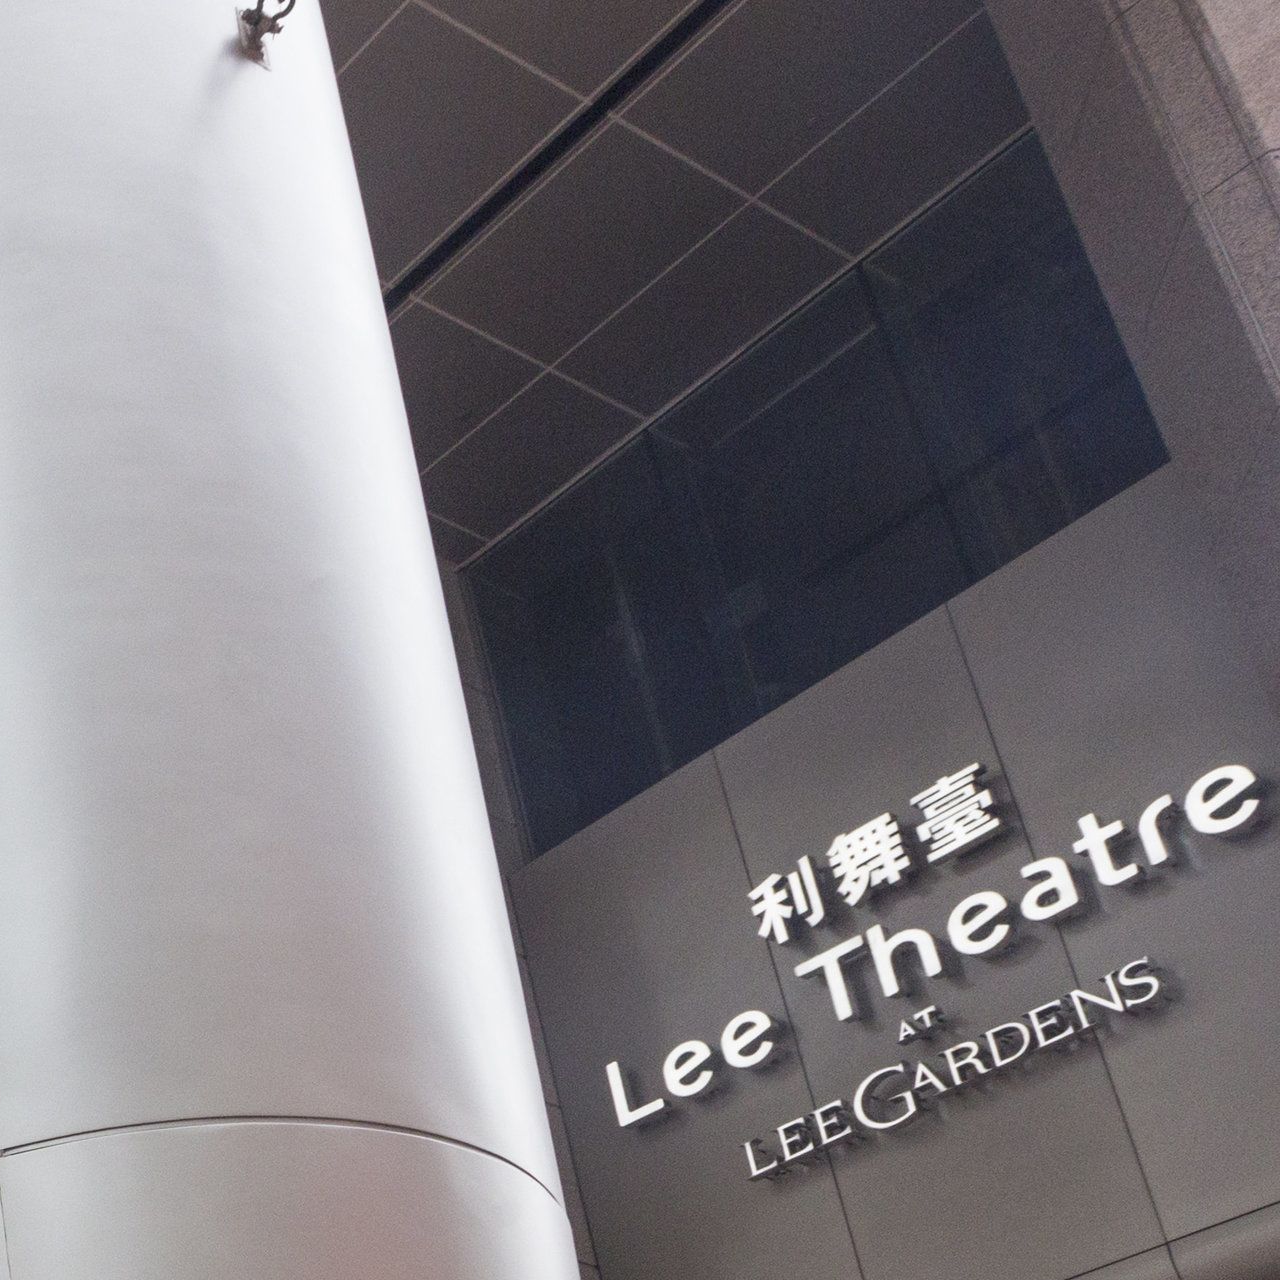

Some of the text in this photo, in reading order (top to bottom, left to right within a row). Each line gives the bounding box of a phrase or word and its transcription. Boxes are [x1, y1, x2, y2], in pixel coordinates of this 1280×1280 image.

[747, 762, 1000, 944] 利舞臺
[605, 763, 1261, 1127] Lee Theatre
[897, 1005, 941, 1044] AT
